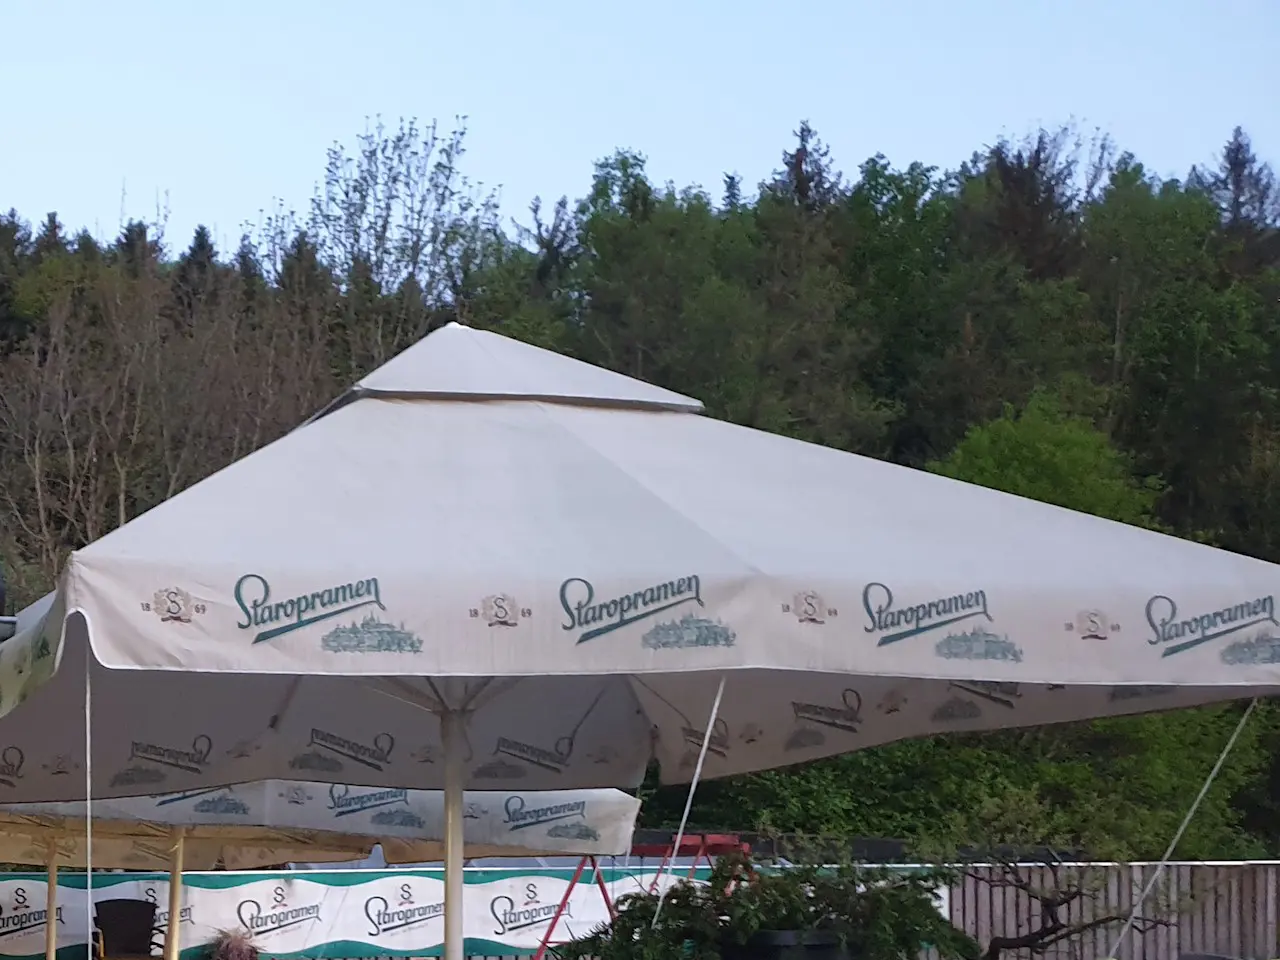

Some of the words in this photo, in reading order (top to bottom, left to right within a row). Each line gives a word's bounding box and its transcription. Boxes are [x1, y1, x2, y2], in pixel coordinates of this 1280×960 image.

[140, 602, 151, 612] 18
[194, 604, 207, 615] 69
[234, 573, 385, 631] Staropramen
[558, 573, 704, 631] Staropramen
[862, 581, 992, 633] Staropramen
[1145, 594, 1280, 646] Staropramen
[14, 887, 28, 904] S
[273, 886, 286, 903] S
[400, 883, 412, 901] S
[525, 883, 538, 900] S
[237, 899, 322, 939] Staropramen
